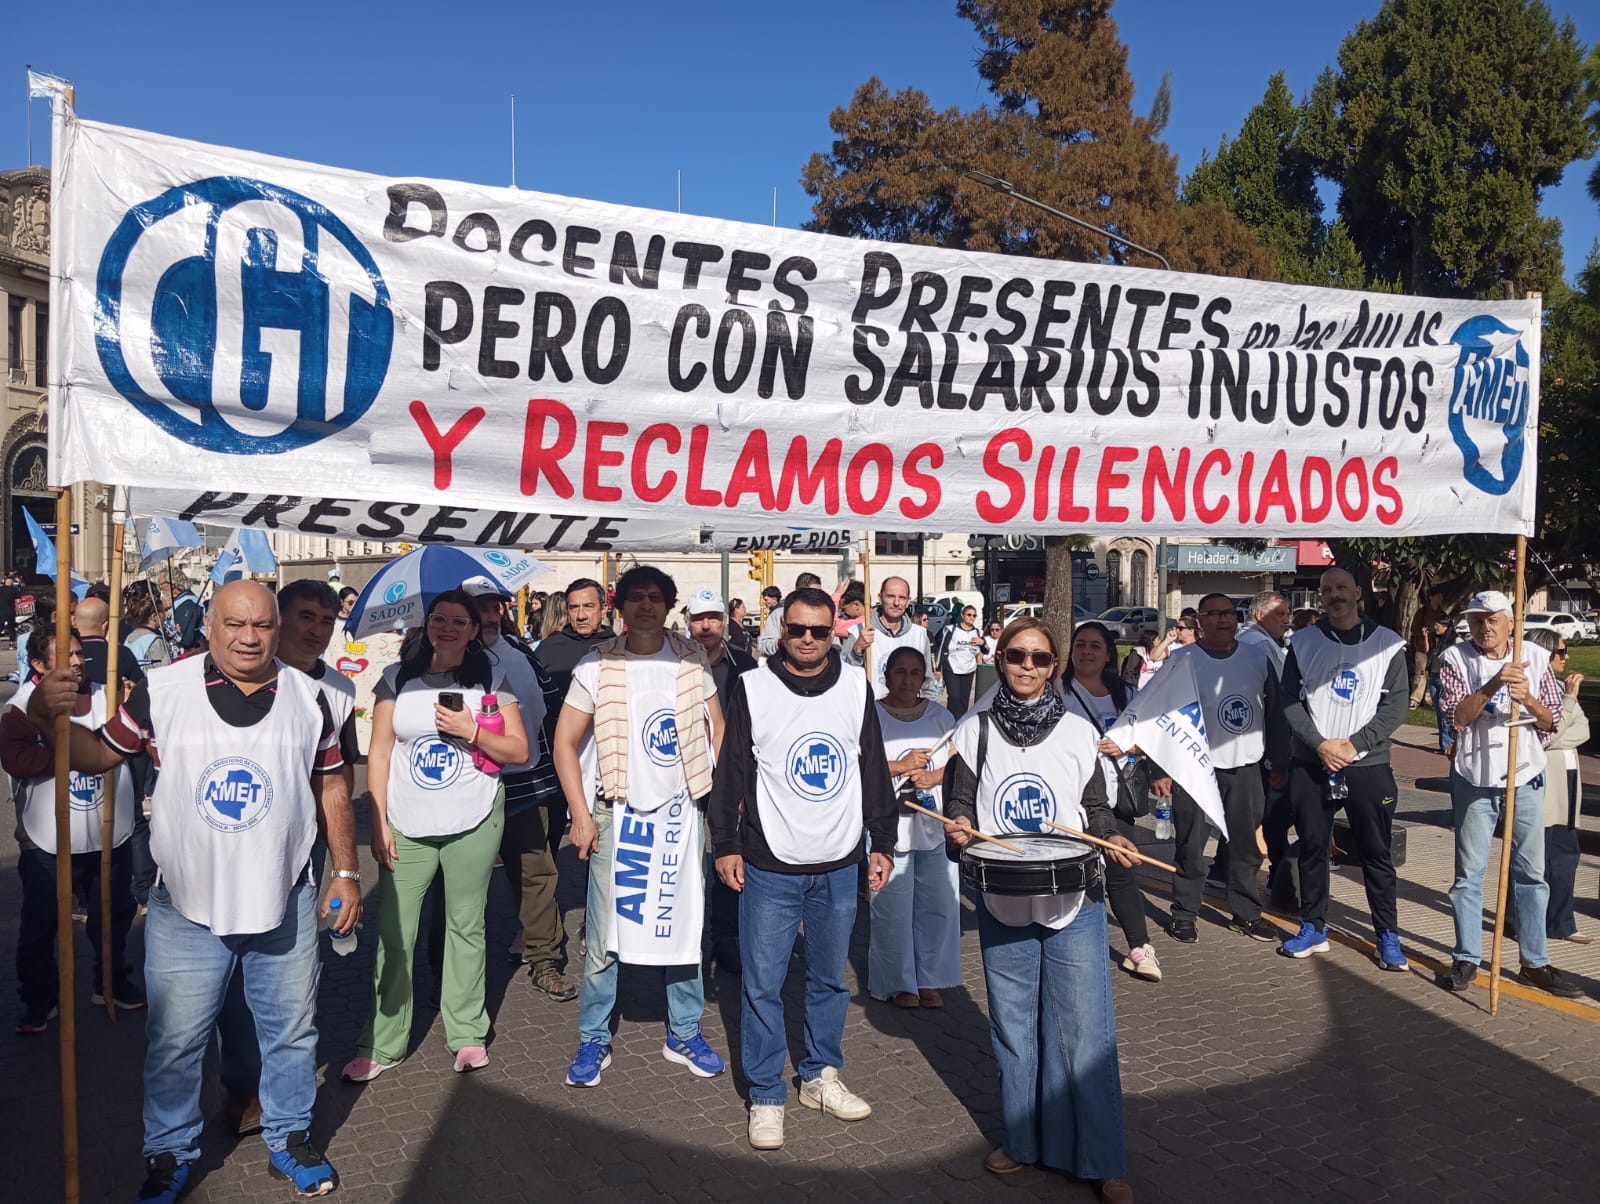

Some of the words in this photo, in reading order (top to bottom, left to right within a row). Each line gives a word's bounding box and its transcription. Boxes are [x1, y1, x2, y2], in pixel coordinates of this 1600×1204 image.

[382, 182, 818, 315] DOCENTES
[850, 250, 1233, 350] PRESENTES
[118, 198, 379, 437] CGT
[422, 280, 631, 385] PERO
[667, 303, 814, 401] CON
[844, 325, 1162, 418] SALARIOS
[1187, 348, 1435, 434] INJUSTOS
[409, 400, 486, 491] Y
[520, 398, 944, 521] RECLAMOS
[975, 427, 1405, 526] SILENCIADOS
[178, 490, 630, 552] PRESENTE
[733, 533, 802, 551] ENTRE
[805, 529, 851, 549] RIOS
[500, 559, 529, 581] SADOP
[369, 601, 415, 623] SADOP
[1331, 677, 1360, 691] AMET
[1223, 707, 1249, 721] AMET
[649, 726, 677, 749] AME
[1154, 713, 1211, 769] ENTRE
[415, 751, 456, 768] AMET
[794, 754, 837, 776] AMET
[204, 780, 262, 804] AMET
[1004, 797, 1050, 820] AMET
[614, 802, 655, 926] AME
[654, 853, 678, 939] ENTRE
